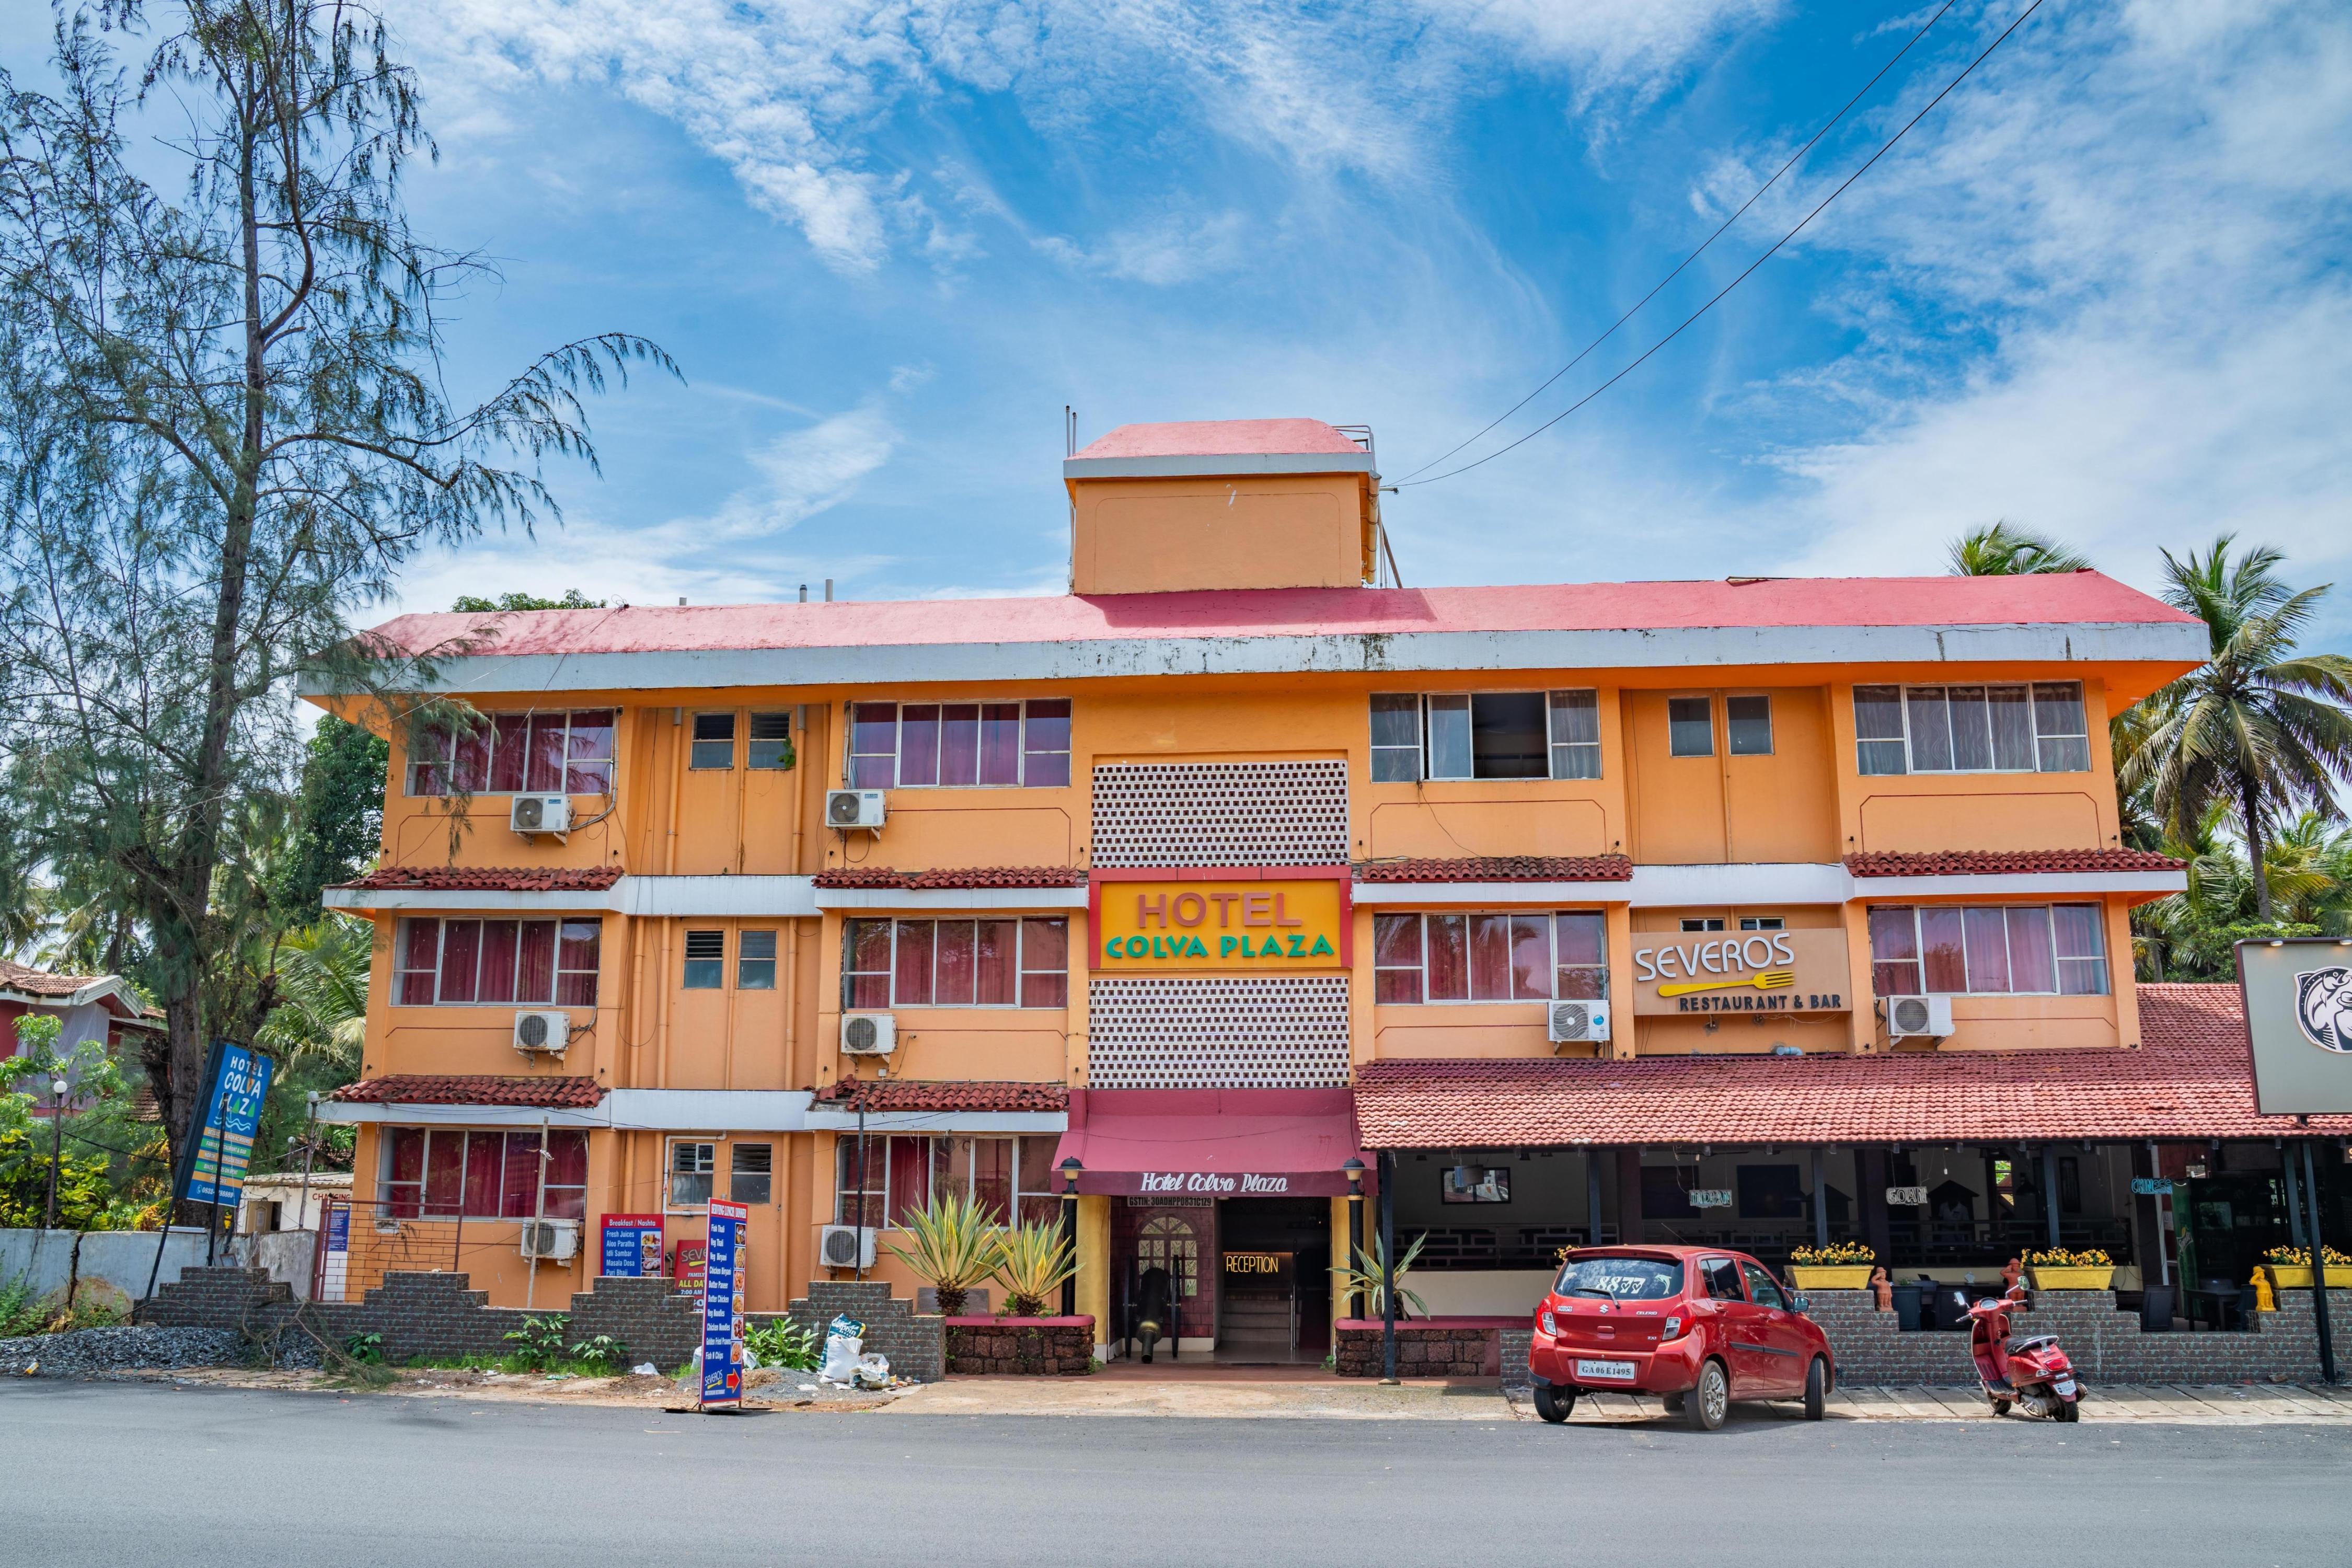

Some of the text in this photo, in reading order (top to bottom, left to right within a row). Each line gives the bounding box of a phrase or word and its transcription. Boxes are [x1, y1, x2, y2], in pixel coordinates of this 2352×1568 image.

[1138, 892, 1302, 928] HOTEL
[1106, 933, 1334, 958] COLVA PLAZA
[1635, 932, 1795, 982] SEVEROS
[1679, 994, 1841, 1011] RESTAURANT & BAR
[1140, 1172, 1288, 1193] Hotel Colva Plaza
[1129, 1197, 1150, 1206] GSTIN:
[1690, 1191, 1731, 1204] INDIAN
[1887, 1187, 1927, 1204] GOAN
[717, 1253, 727, 1262] Biryani
[1226, 1256, 1278, 1273] RECEPTION
[709, 1266, 721, 1275] Chicken
[721, 1267, 732, 1276] Biryani
[1596, 1276, 1646, 1294] 8877
[715, 1352, 723, 1361] Chips
[705, 1369, 723, 1387] SEVEROS
